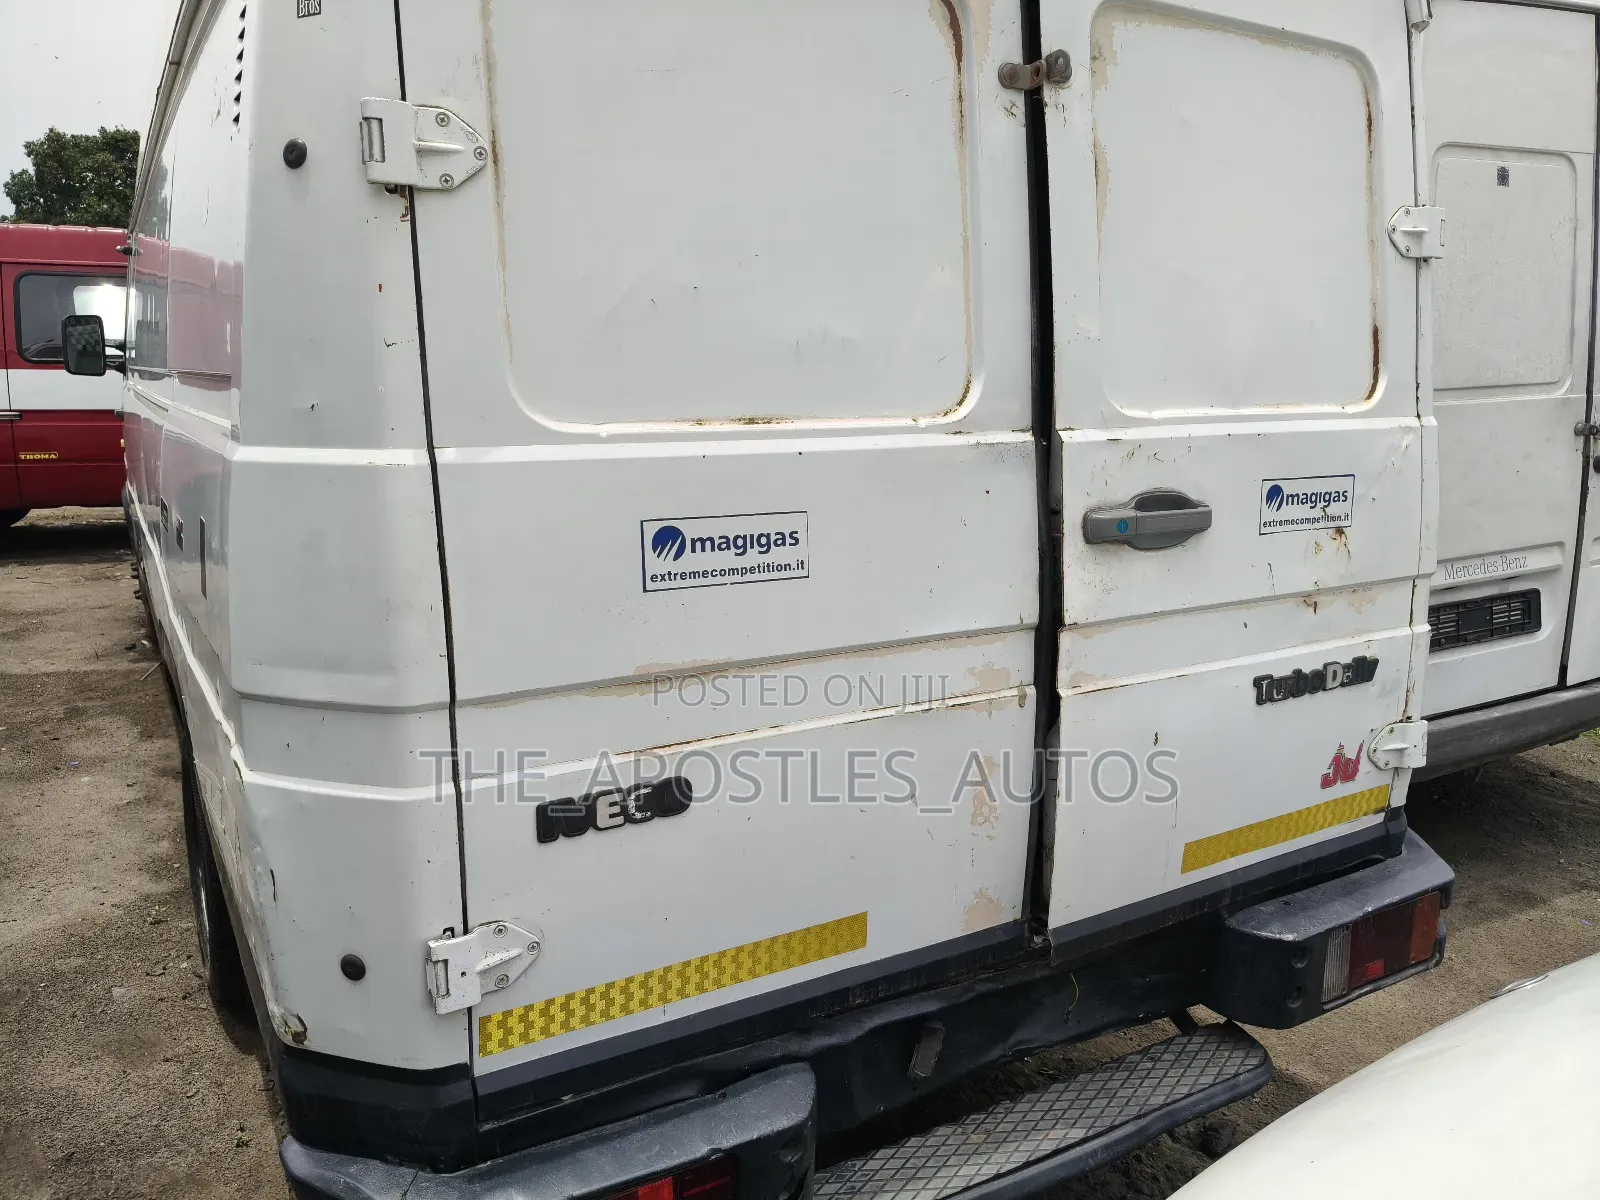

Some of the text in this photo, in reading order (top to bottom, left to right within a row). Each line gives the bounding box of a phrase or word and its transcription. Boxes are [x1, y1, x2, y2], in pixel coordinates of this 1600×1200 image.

[298, 0, 320, 16] Bros
[1285, 490, 1348, 509] magigas
[1263, 513, 1350, 528] extremecompetition.it
[690, 530, 800, 557] magigas
[650, 559, 805, 583] extremecompetition.it
[1444, 555, 1528, 580] Mercedes-Benz
